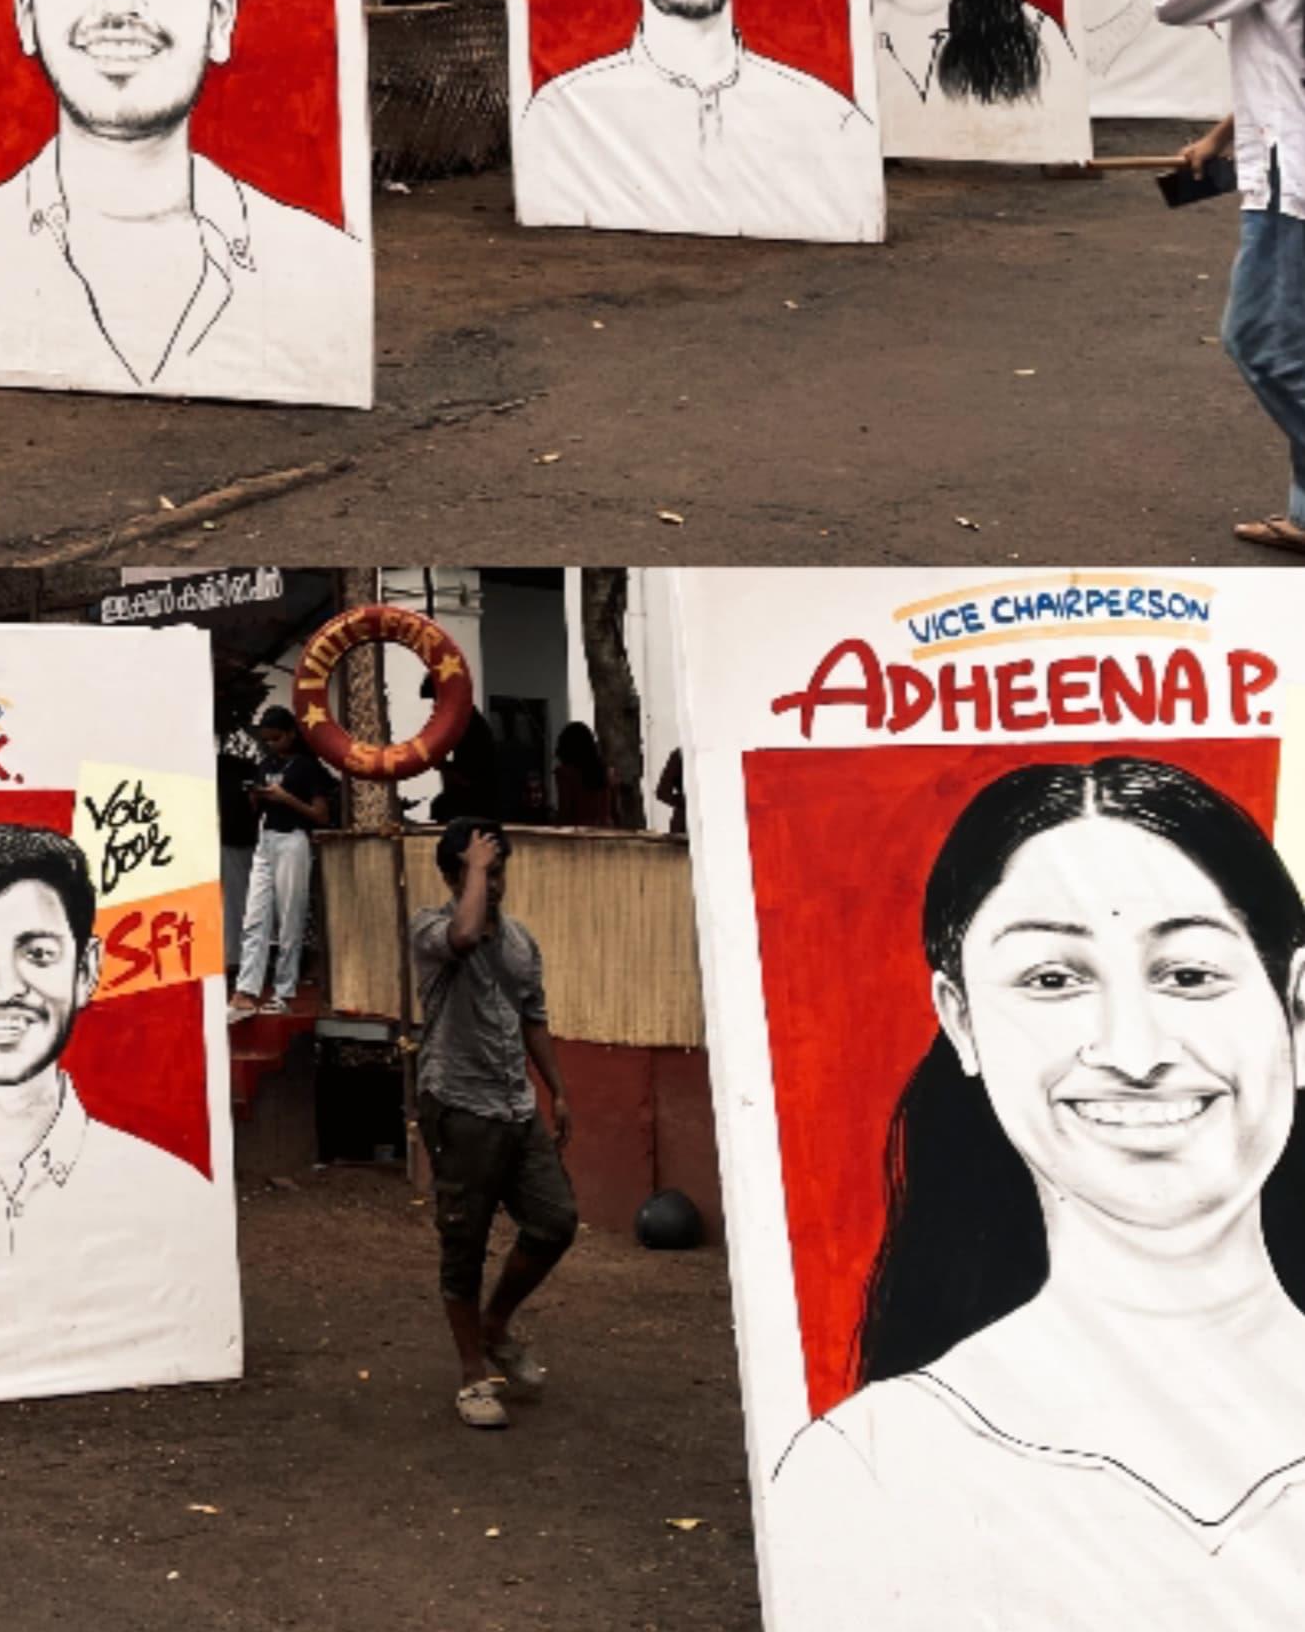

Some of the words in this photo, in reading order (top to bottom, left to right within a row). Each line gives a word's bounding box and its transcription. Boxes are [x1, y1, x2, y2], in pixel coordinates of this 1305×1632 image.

[908, 603, 986, 644] VICE
[992, 586, 1210, 626] CHAIRPERSON
[771, 637, 1209, 740] ADHEENA
[1228, 648, 1278, 727] P.
[84, 780, 161, 830] Vote
[101, 823, 175, 895] for
